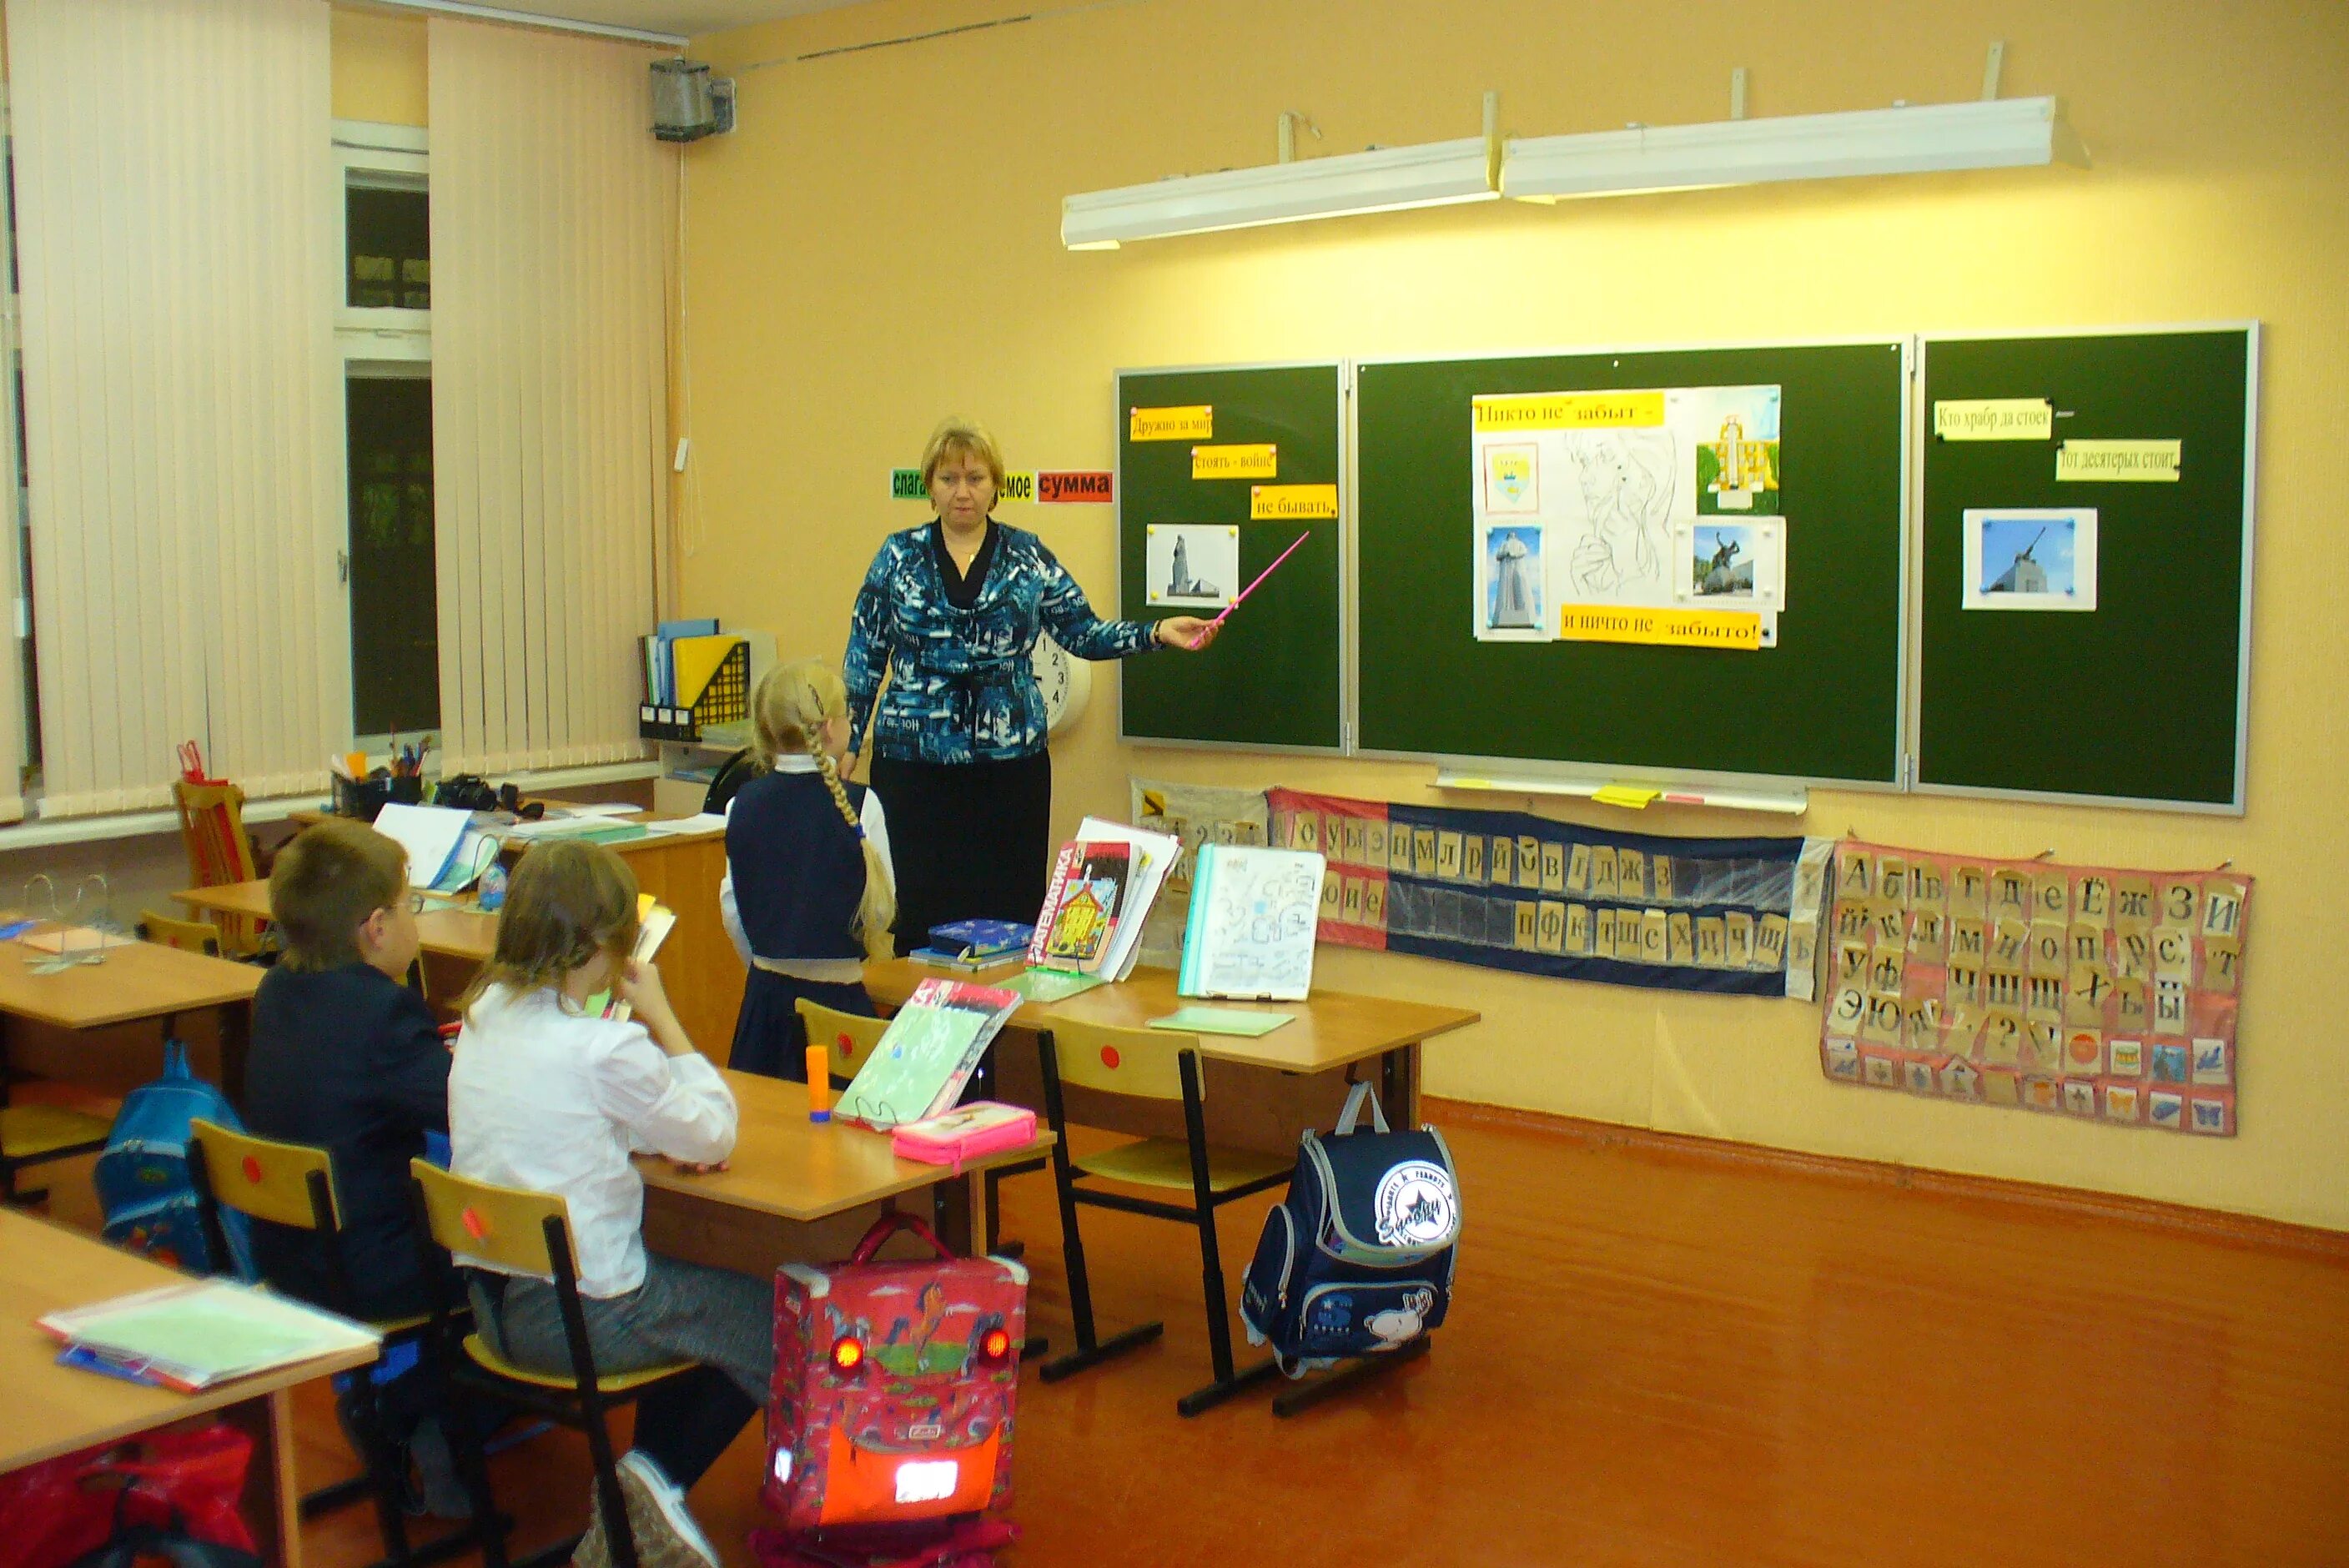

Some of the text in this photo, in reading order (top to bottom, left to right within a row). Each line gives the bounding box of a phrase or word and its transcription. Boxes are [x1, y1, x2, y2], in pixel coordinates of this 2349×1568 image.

[1478, 404, 1536, 422] Никто
[1542, 407, 1563, 420] не
[1577, 404, 1636, 420] забыт
[1939, 406, 2050, 432] Кто храбр да стоек
[1133, 416, 1212, 436] Дружно за мир
[1195, 456, 1230, 469] стоять
[1240, 451, 1272, 468] войне
[2082, 451, 2139, 475] десятерых
[1039, 475, 1110, 499] сумма
[1257, 501, 1274, 515] не
[1564, 615, 1757, 641] и ничто не забыто!
[1043, 637, 1046, 651] 1
[1052, 652, 1059, 666] 2
[1058, 671, 1064, 685] 3
[1052, 689, 1059, 703] 4
